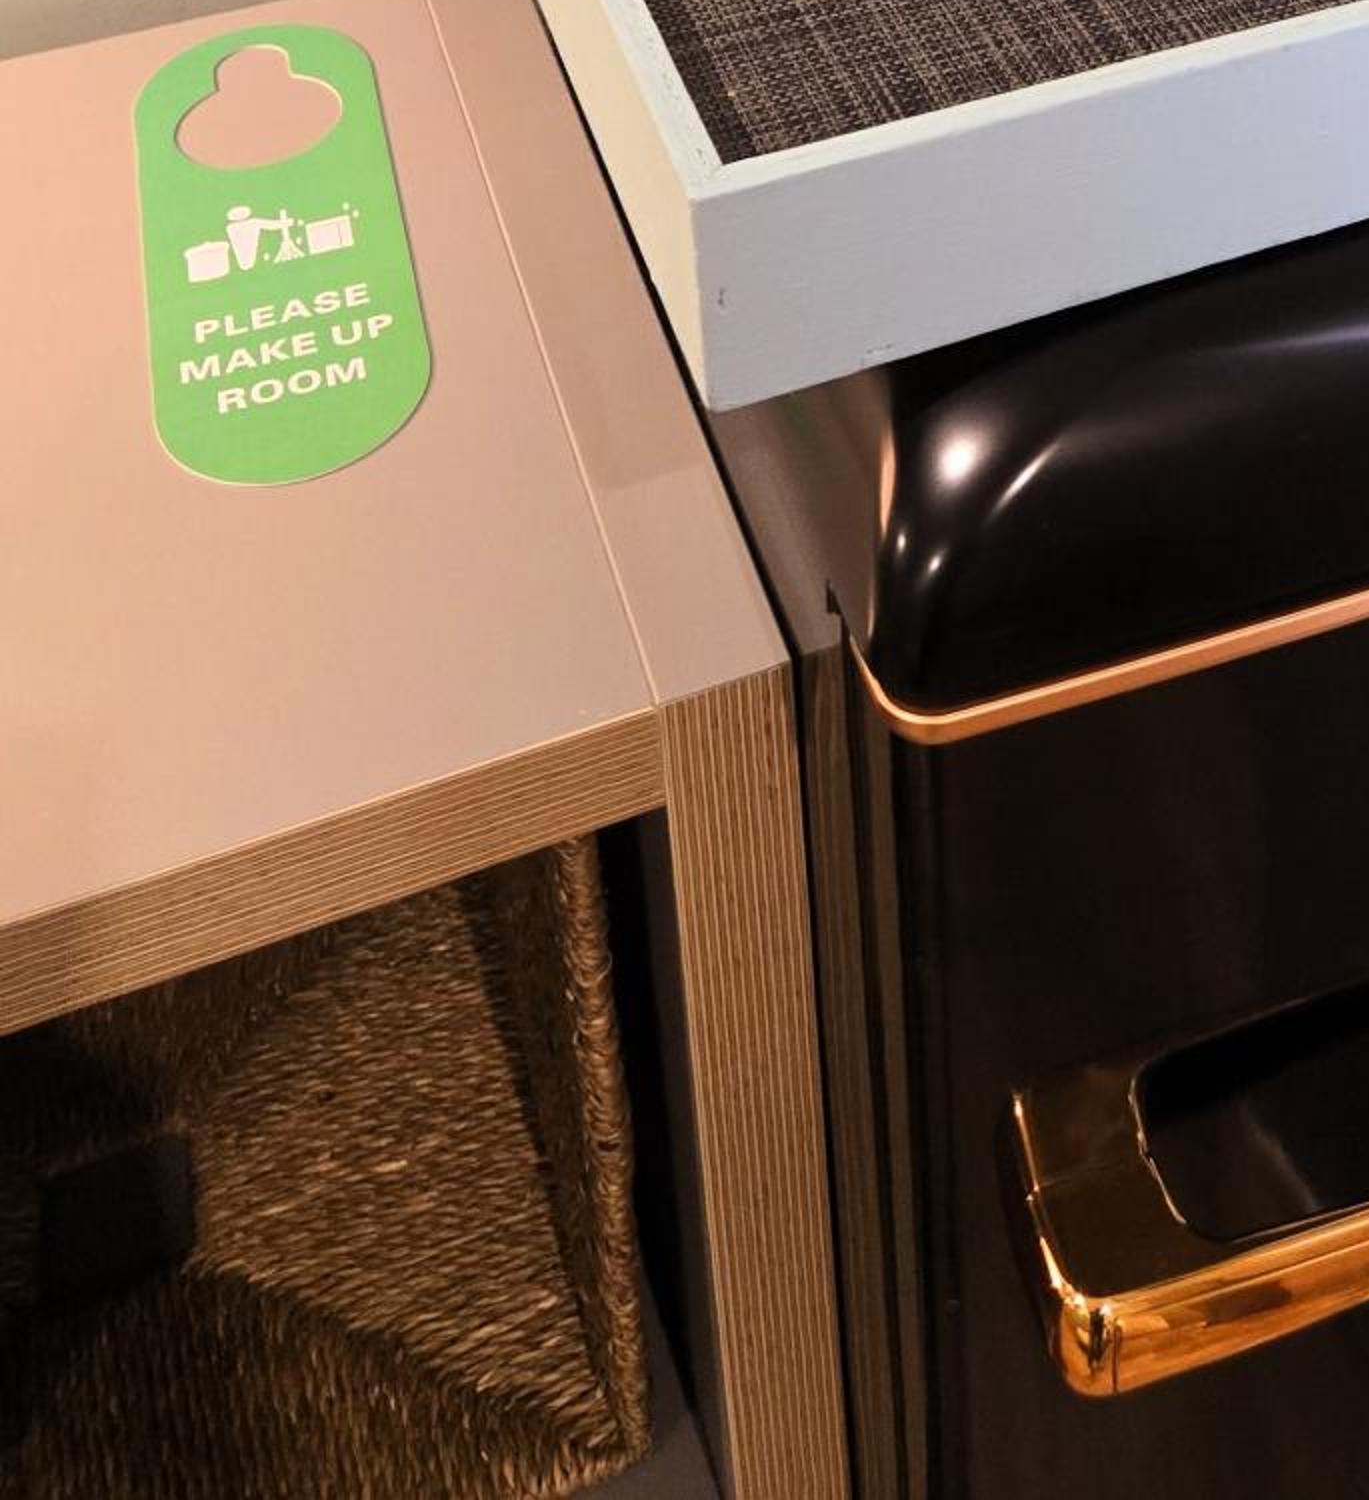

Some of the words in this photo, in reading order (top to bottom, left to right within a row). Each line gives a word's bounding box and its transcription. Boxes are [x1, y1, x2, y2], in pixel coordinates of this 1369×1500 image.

[193, 282, 371, 344] PLEASE
[179, 330, 319, 385] MAKE
[331, 313, 394, 346] UP
[216, 355, 368, 415] ROOM
